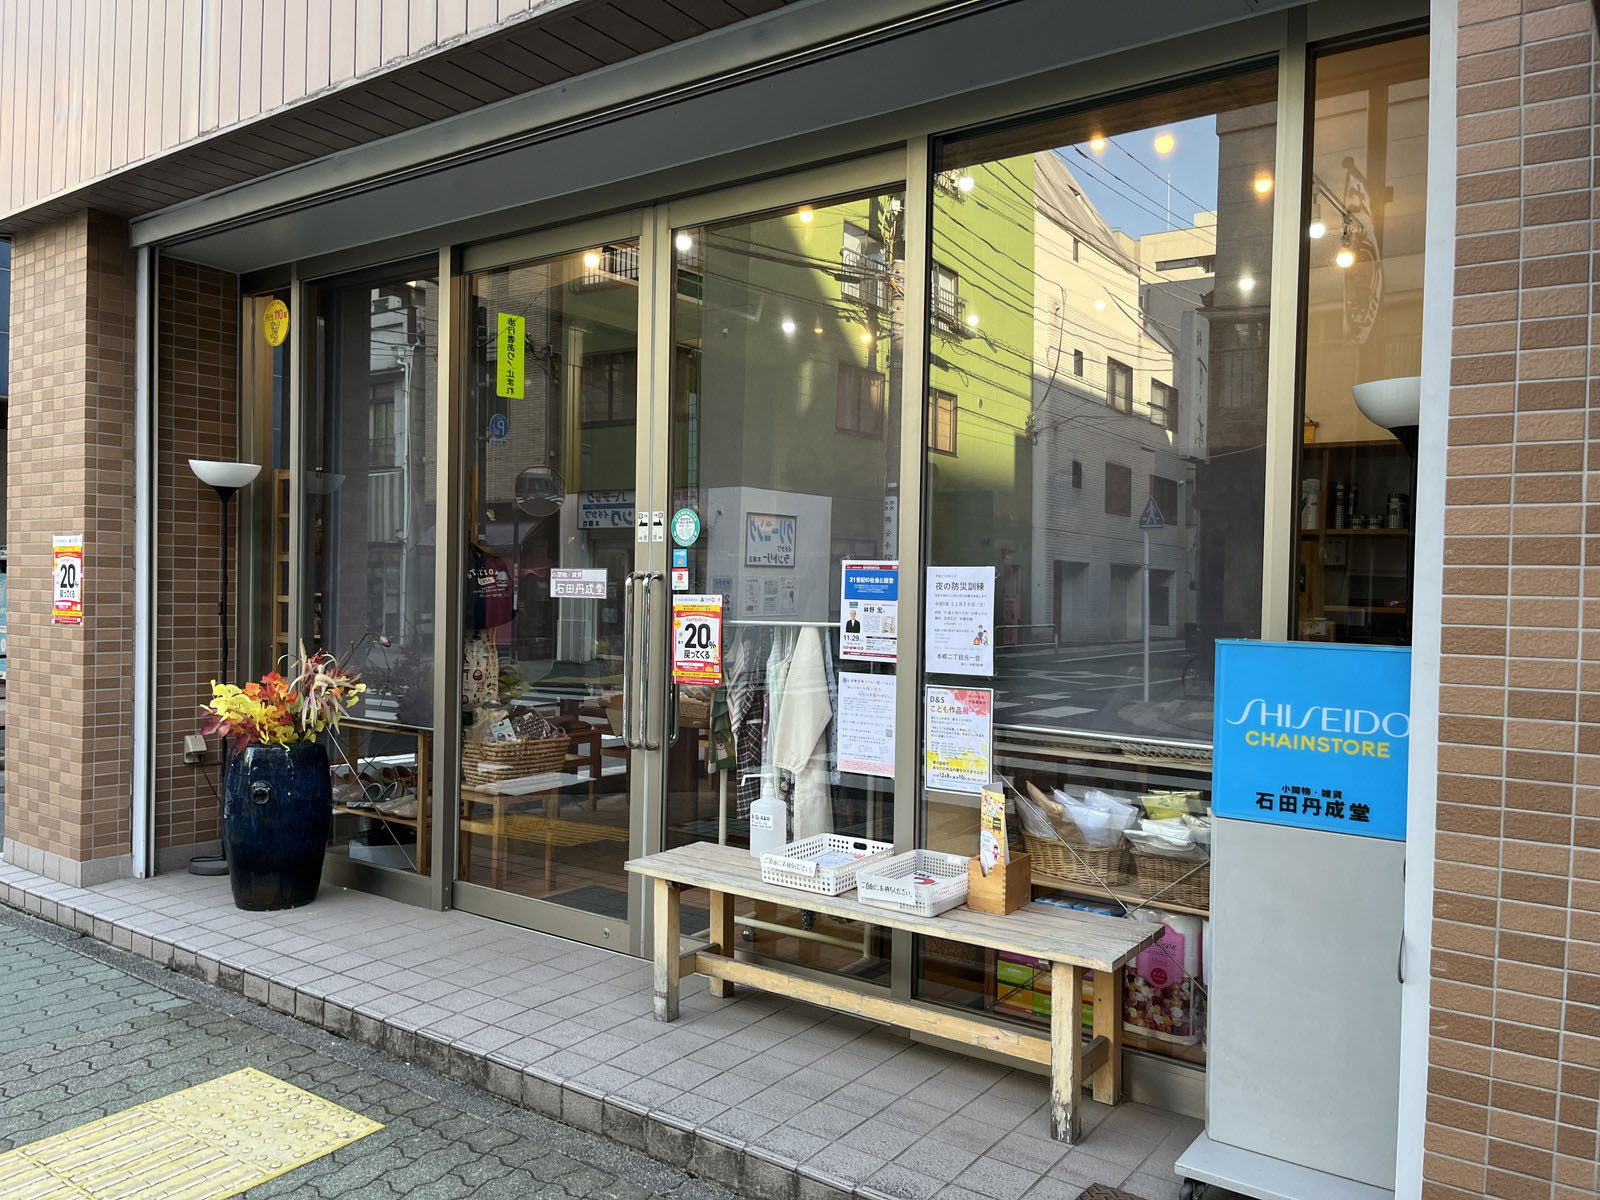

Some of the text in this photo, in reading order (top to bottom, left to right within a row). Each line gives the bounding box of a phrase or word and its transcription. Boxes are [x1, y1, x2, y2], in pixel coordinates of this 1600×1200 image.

[556, 583, 605, 596] 石田丹成堂
[935, 582, 984, 591] 夜の防災訓練
[684, 650, 710, 660] 戻ってくる
[1226, 698, 1410, 738] SHISEIDO
[1245, 730, 1391, 758] CHAINSTORE
[1255, 792, 1370, 823] 石田丹成堂
